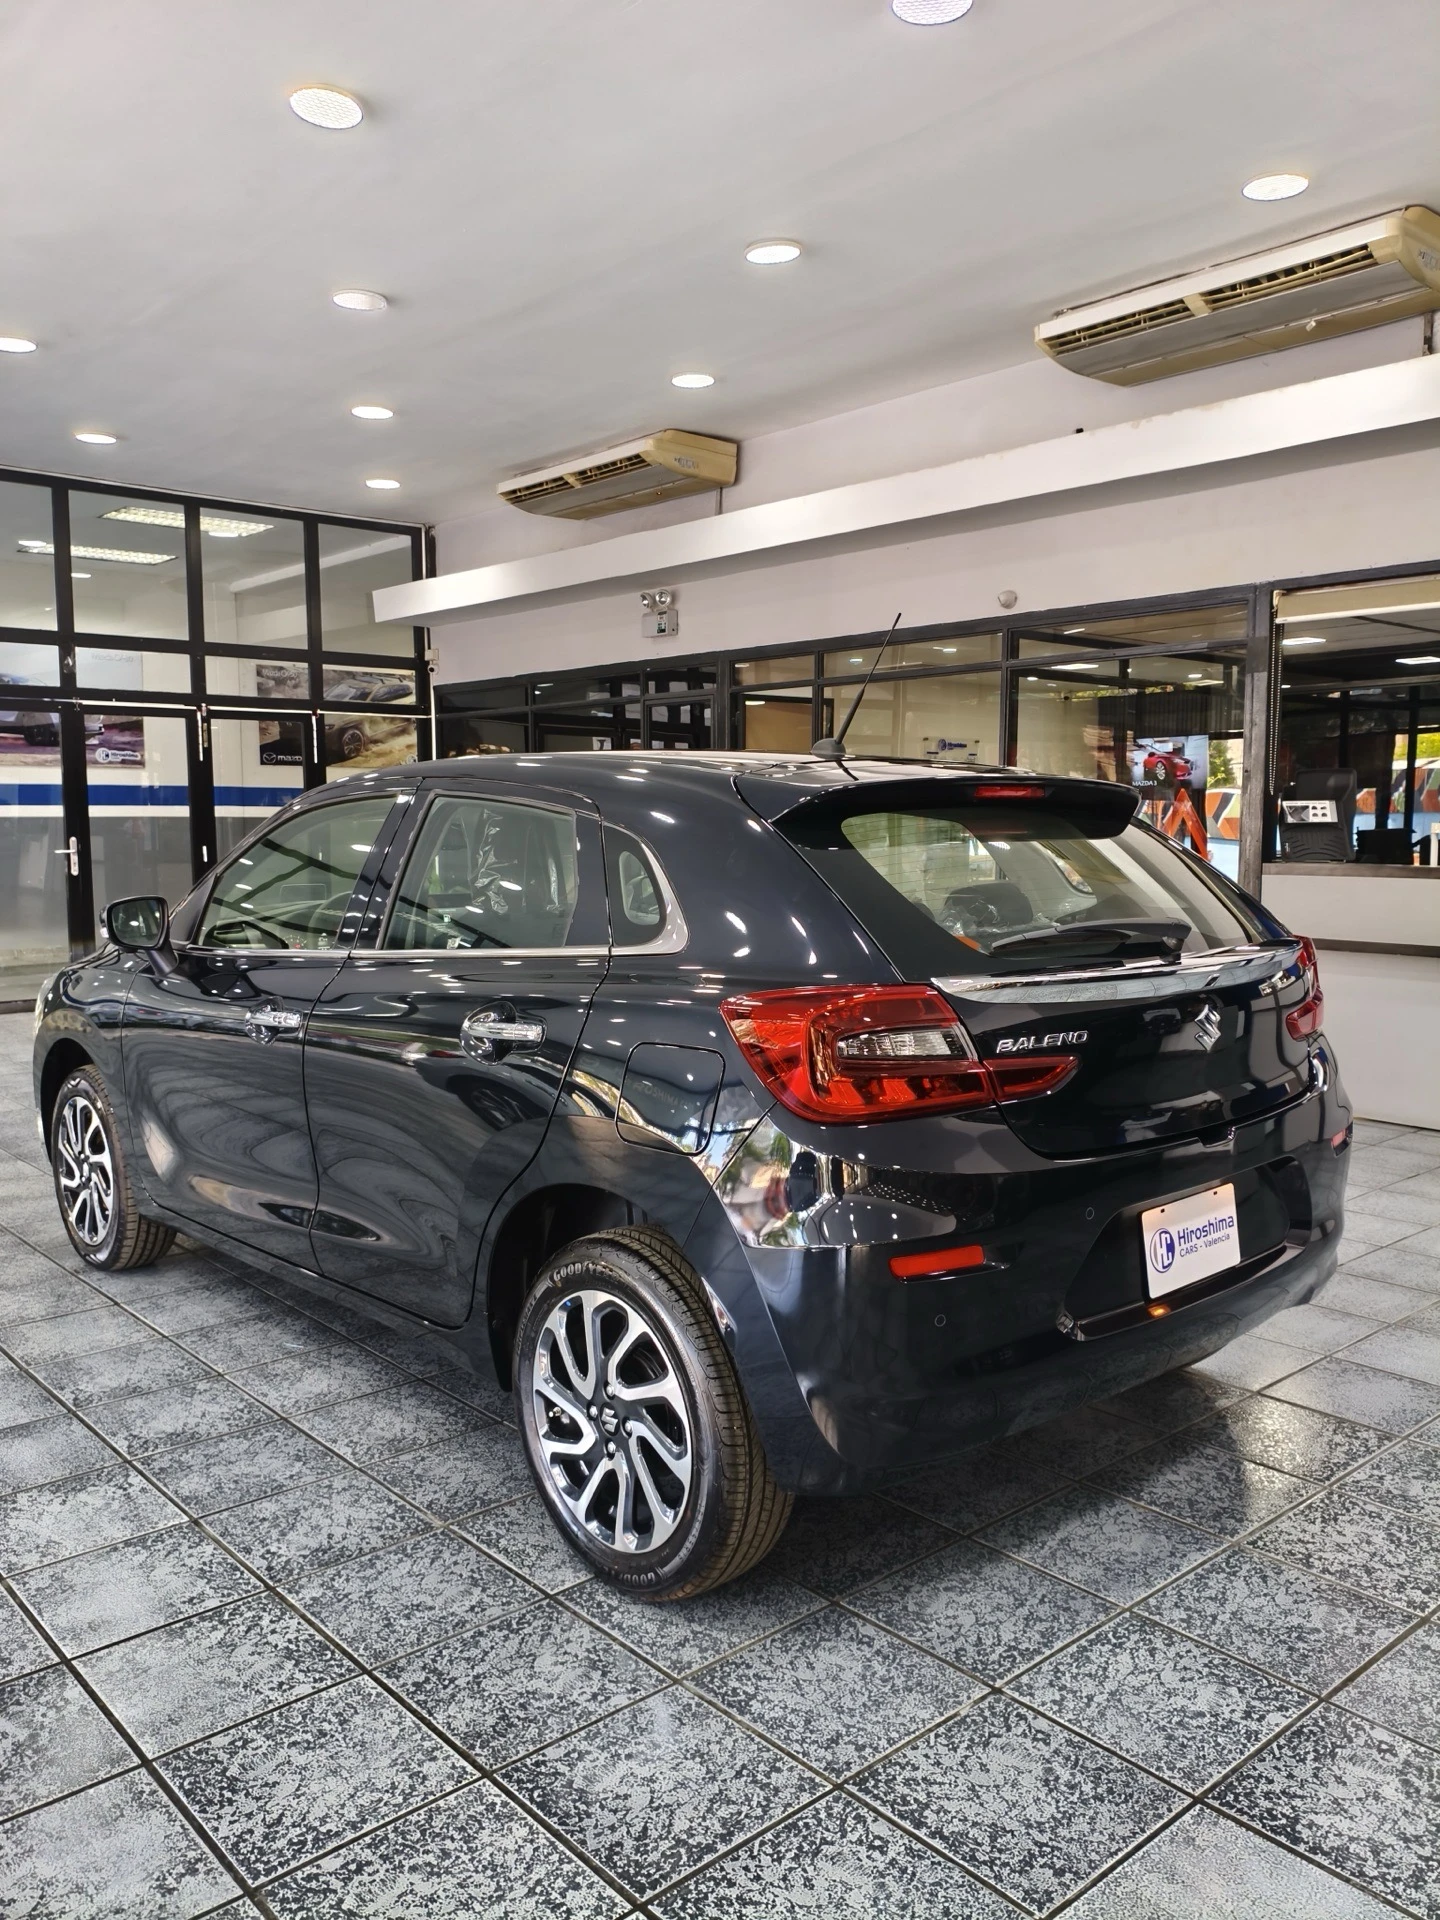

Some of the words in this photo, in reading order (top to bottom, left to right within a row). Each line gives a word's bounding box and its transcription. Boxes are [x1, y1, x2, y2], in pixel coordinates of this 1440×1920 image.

[996, 1030, 1089, 1053] BALENO
[1177, 1215, 1235, 1247] Hiroshima
[1179, 1243, 1199, 1257] CARS
[1203, 1233, 1231, 1248] Valencia
